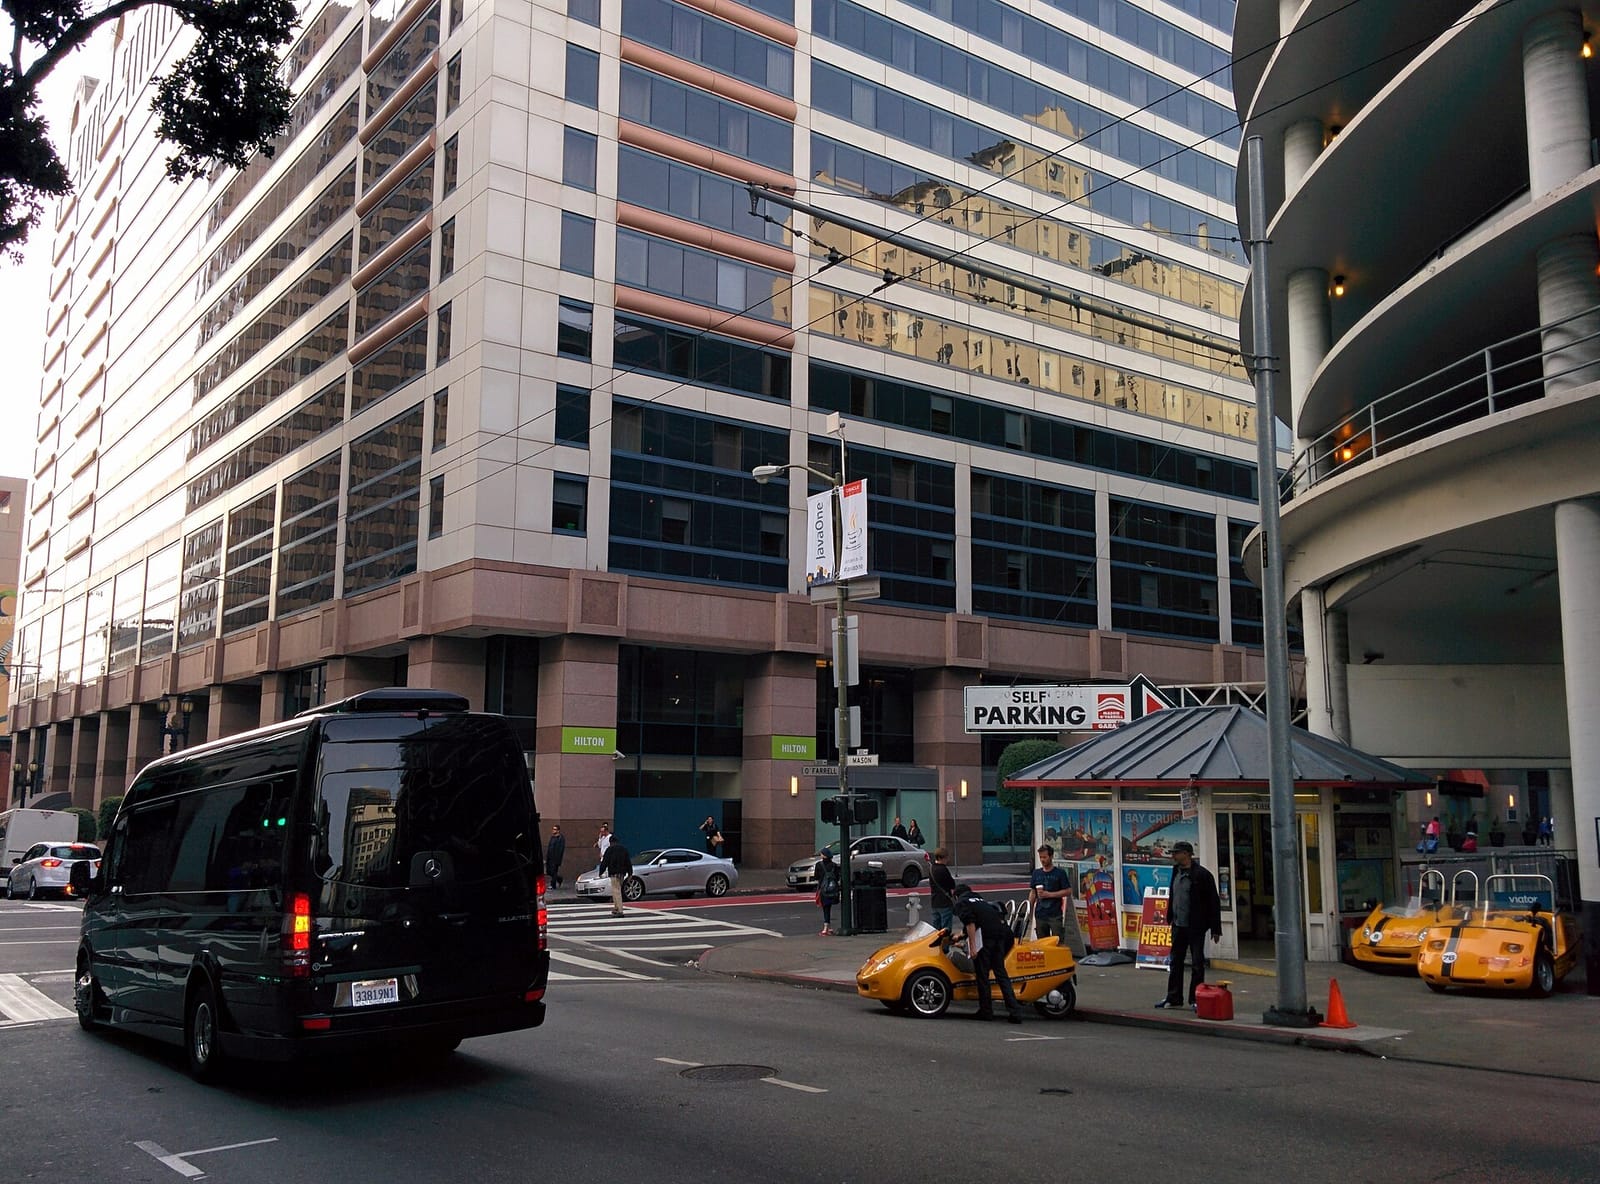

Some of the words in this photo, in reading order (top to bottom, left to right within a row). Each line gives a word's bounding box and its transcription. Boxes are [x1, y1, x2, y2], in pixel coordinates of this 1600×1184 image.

[815, 502, 826, 560] JavaOne
[1012, 691, 1047, 703] SELF
[974, 706, 1086, 725] PARKING
[574, 736, 605, 747] HILTON
[781, 743, 807, 753] HILTON
[804, 767, 838, 775] O'FARRELL
[1125, 813, 1145, 824] BAY
[1508, 895, 1538, 904] viator
[1141, 932, 1173, 947] HERE
[355, 987, 395, 1003] 33819N1
